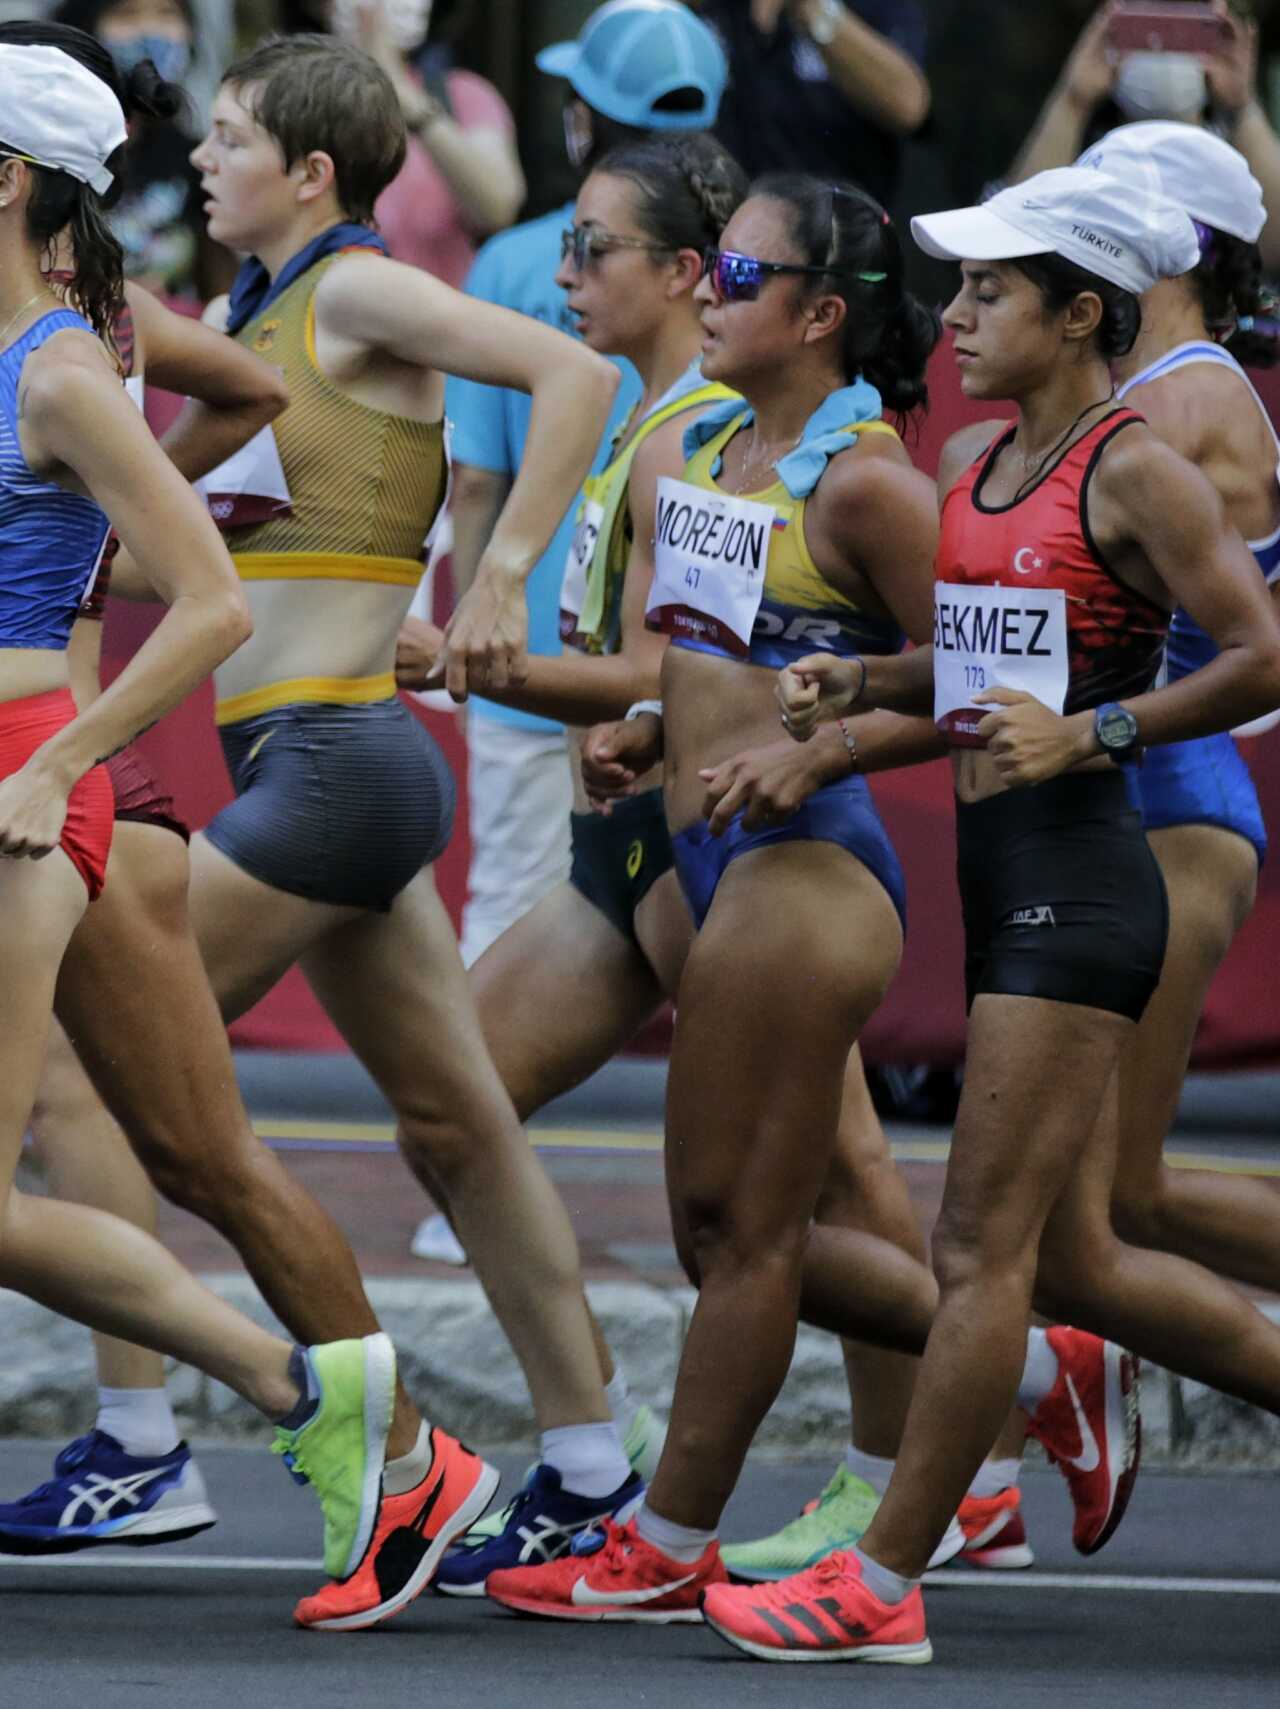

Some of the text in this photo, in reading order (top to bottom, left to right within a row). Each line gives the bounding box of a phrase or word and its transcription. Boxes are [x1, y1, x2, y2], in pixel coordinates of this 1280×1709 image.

[657, 496, 764, 570] MOREJON
[685, 565, 701, 589] 47
[964, 665, 985, 689] 173
